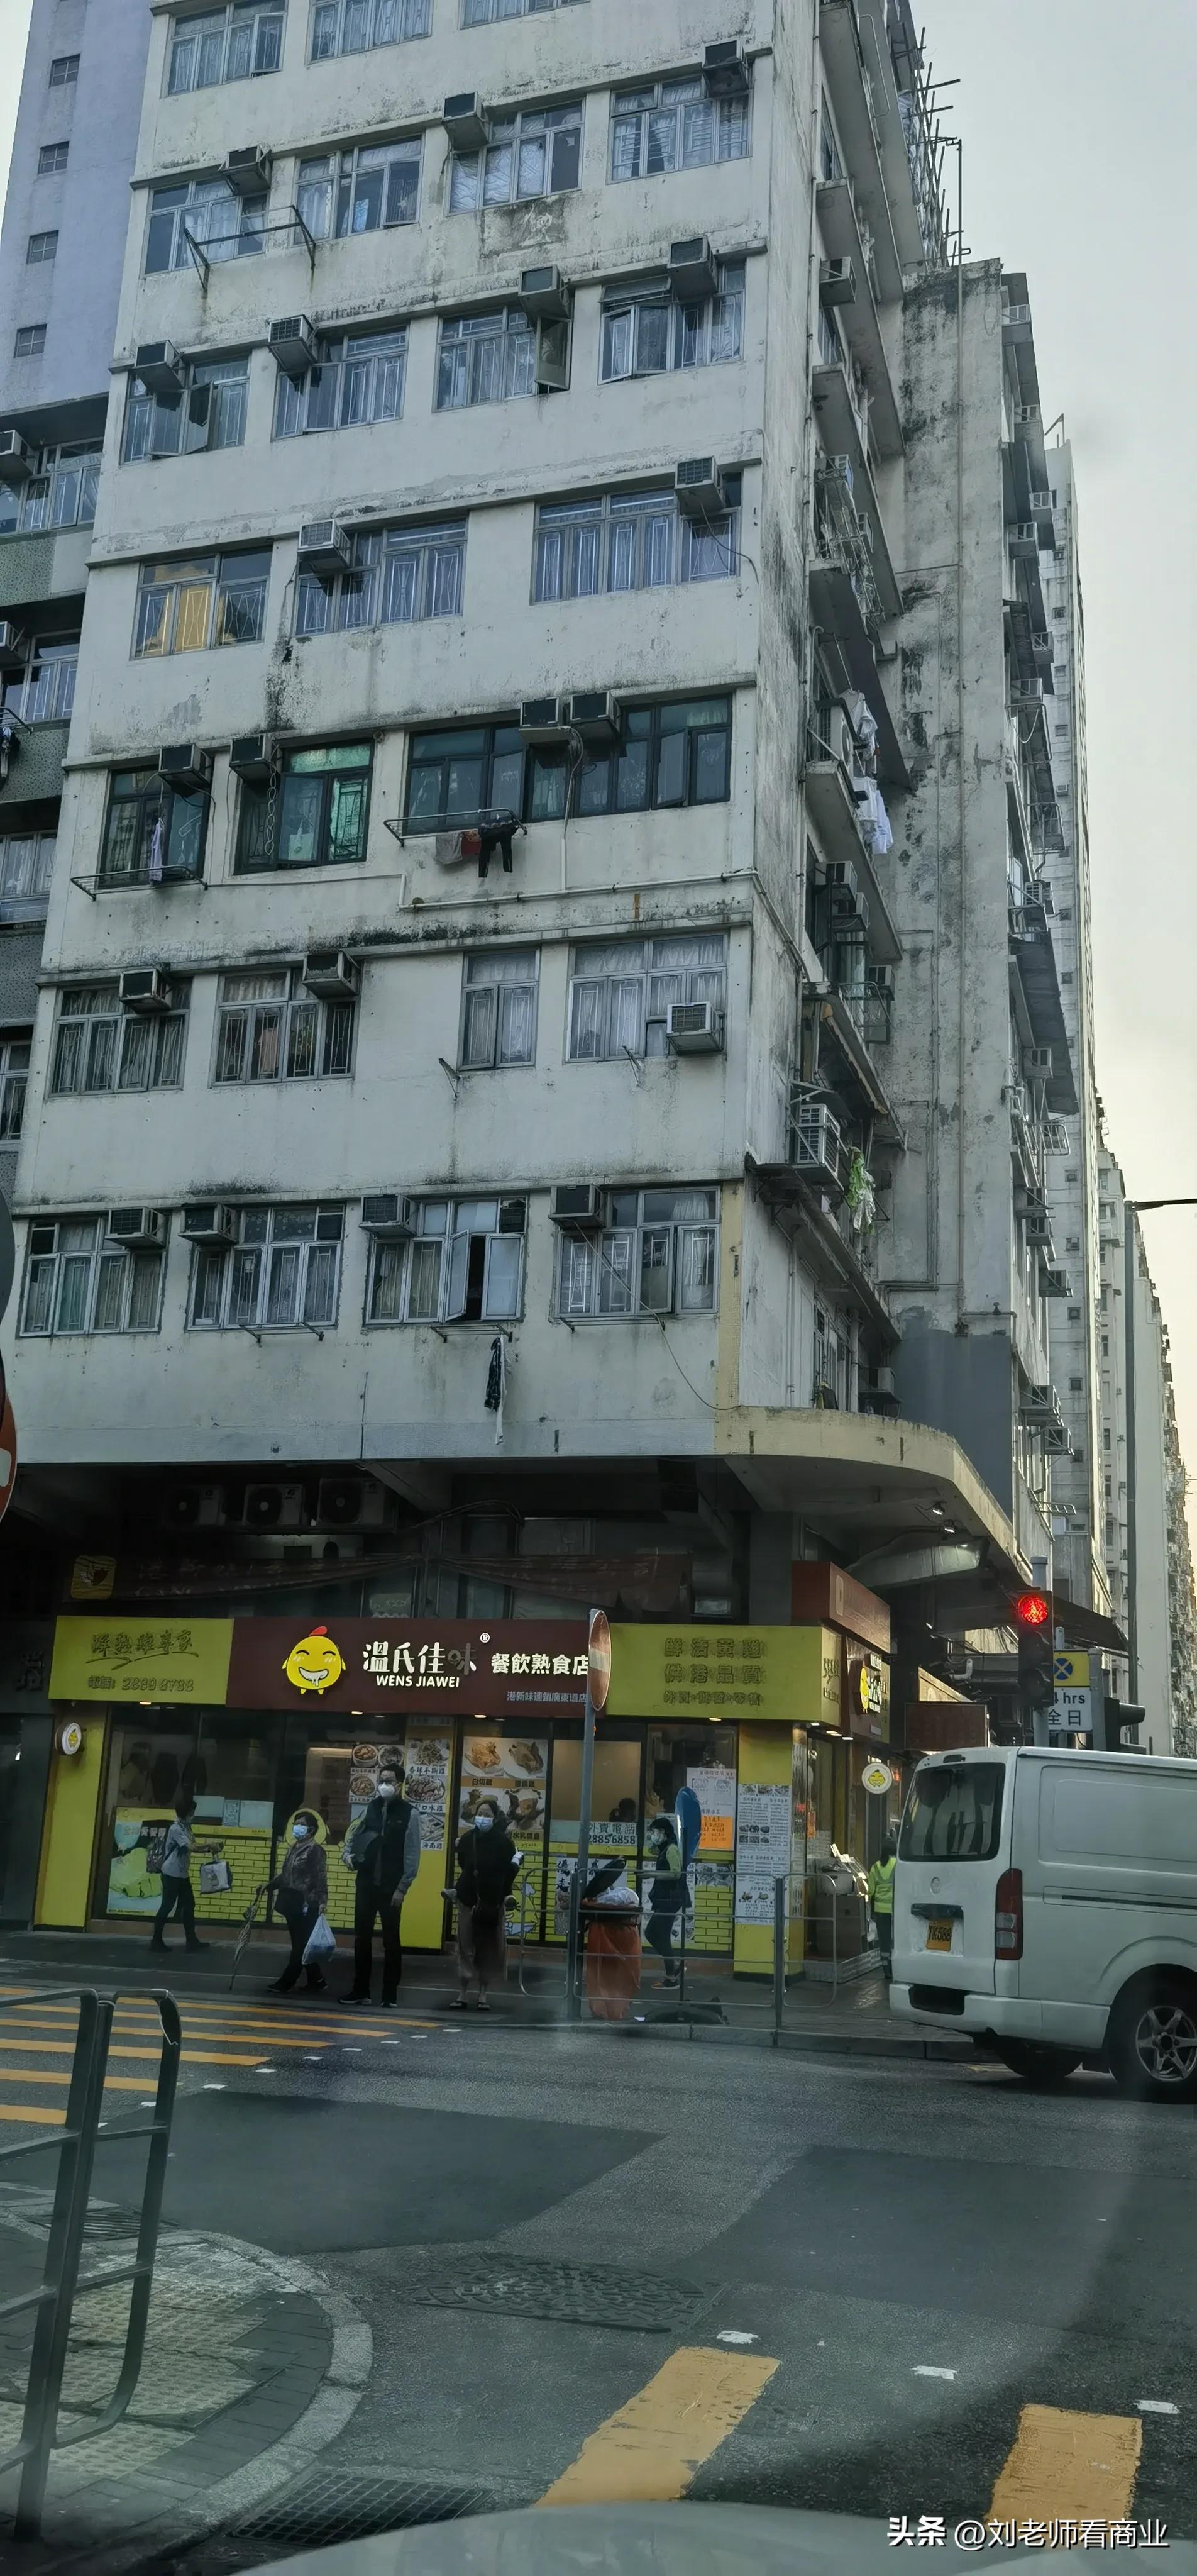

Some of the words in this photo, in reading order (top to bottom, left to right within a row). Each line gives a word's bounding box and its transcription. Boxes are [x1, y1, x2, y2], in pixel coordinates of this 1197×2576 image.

[491, 1653, 589, 1675] 餐飲熟食店
[376, 1675, 412, 1687] WENS
[416, 1675, 460, 1688] JIAWEI
[1062, 1692, 1086, 1704] hrs
[1048, 1709, 1081, 1726] 全日
